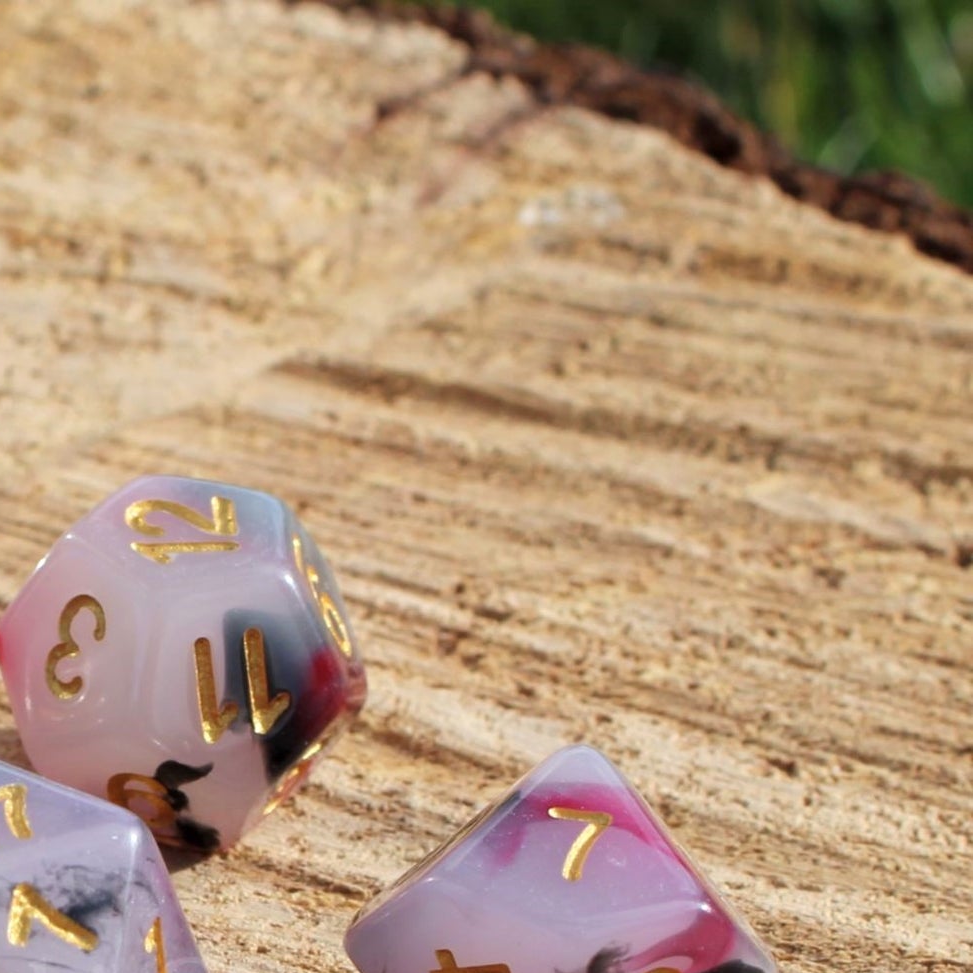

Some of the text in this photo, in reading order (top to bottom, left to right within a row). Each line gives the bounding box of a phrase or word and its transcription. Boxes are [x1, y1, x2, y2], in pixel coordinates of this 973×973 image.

[125, 496, 239, 564] 12
[45, 594, 106, 699] 3
[194, 627, 292, 744] 11
[547, 806, 613, 881] 7
